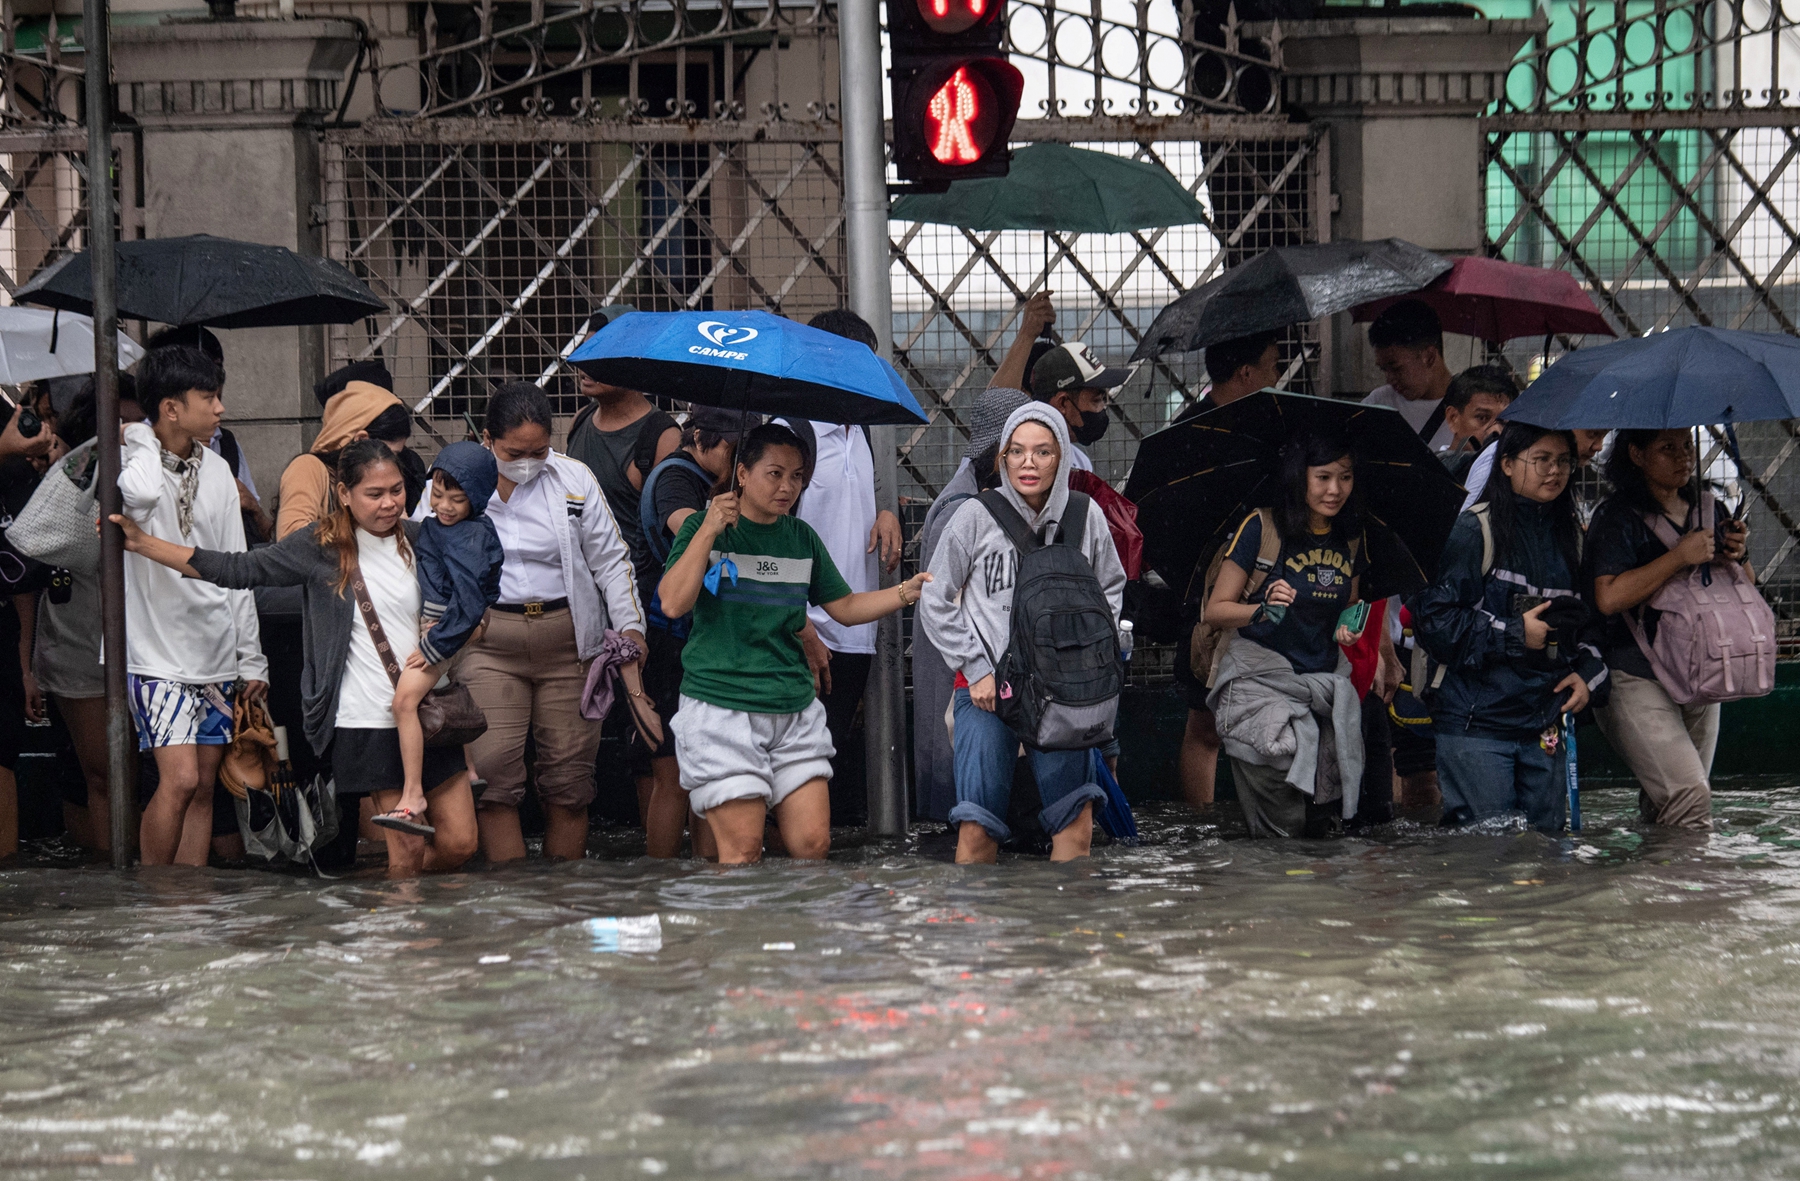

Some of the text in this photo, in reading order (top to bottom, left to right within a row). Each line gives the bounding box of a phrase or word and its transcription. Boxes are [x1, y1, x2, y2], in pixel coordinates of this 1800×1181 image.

[688, 345, 749, 360] CAMPE
[756, 561, 778, 571] J&G
[1307, 573, 1316, 583] 19
